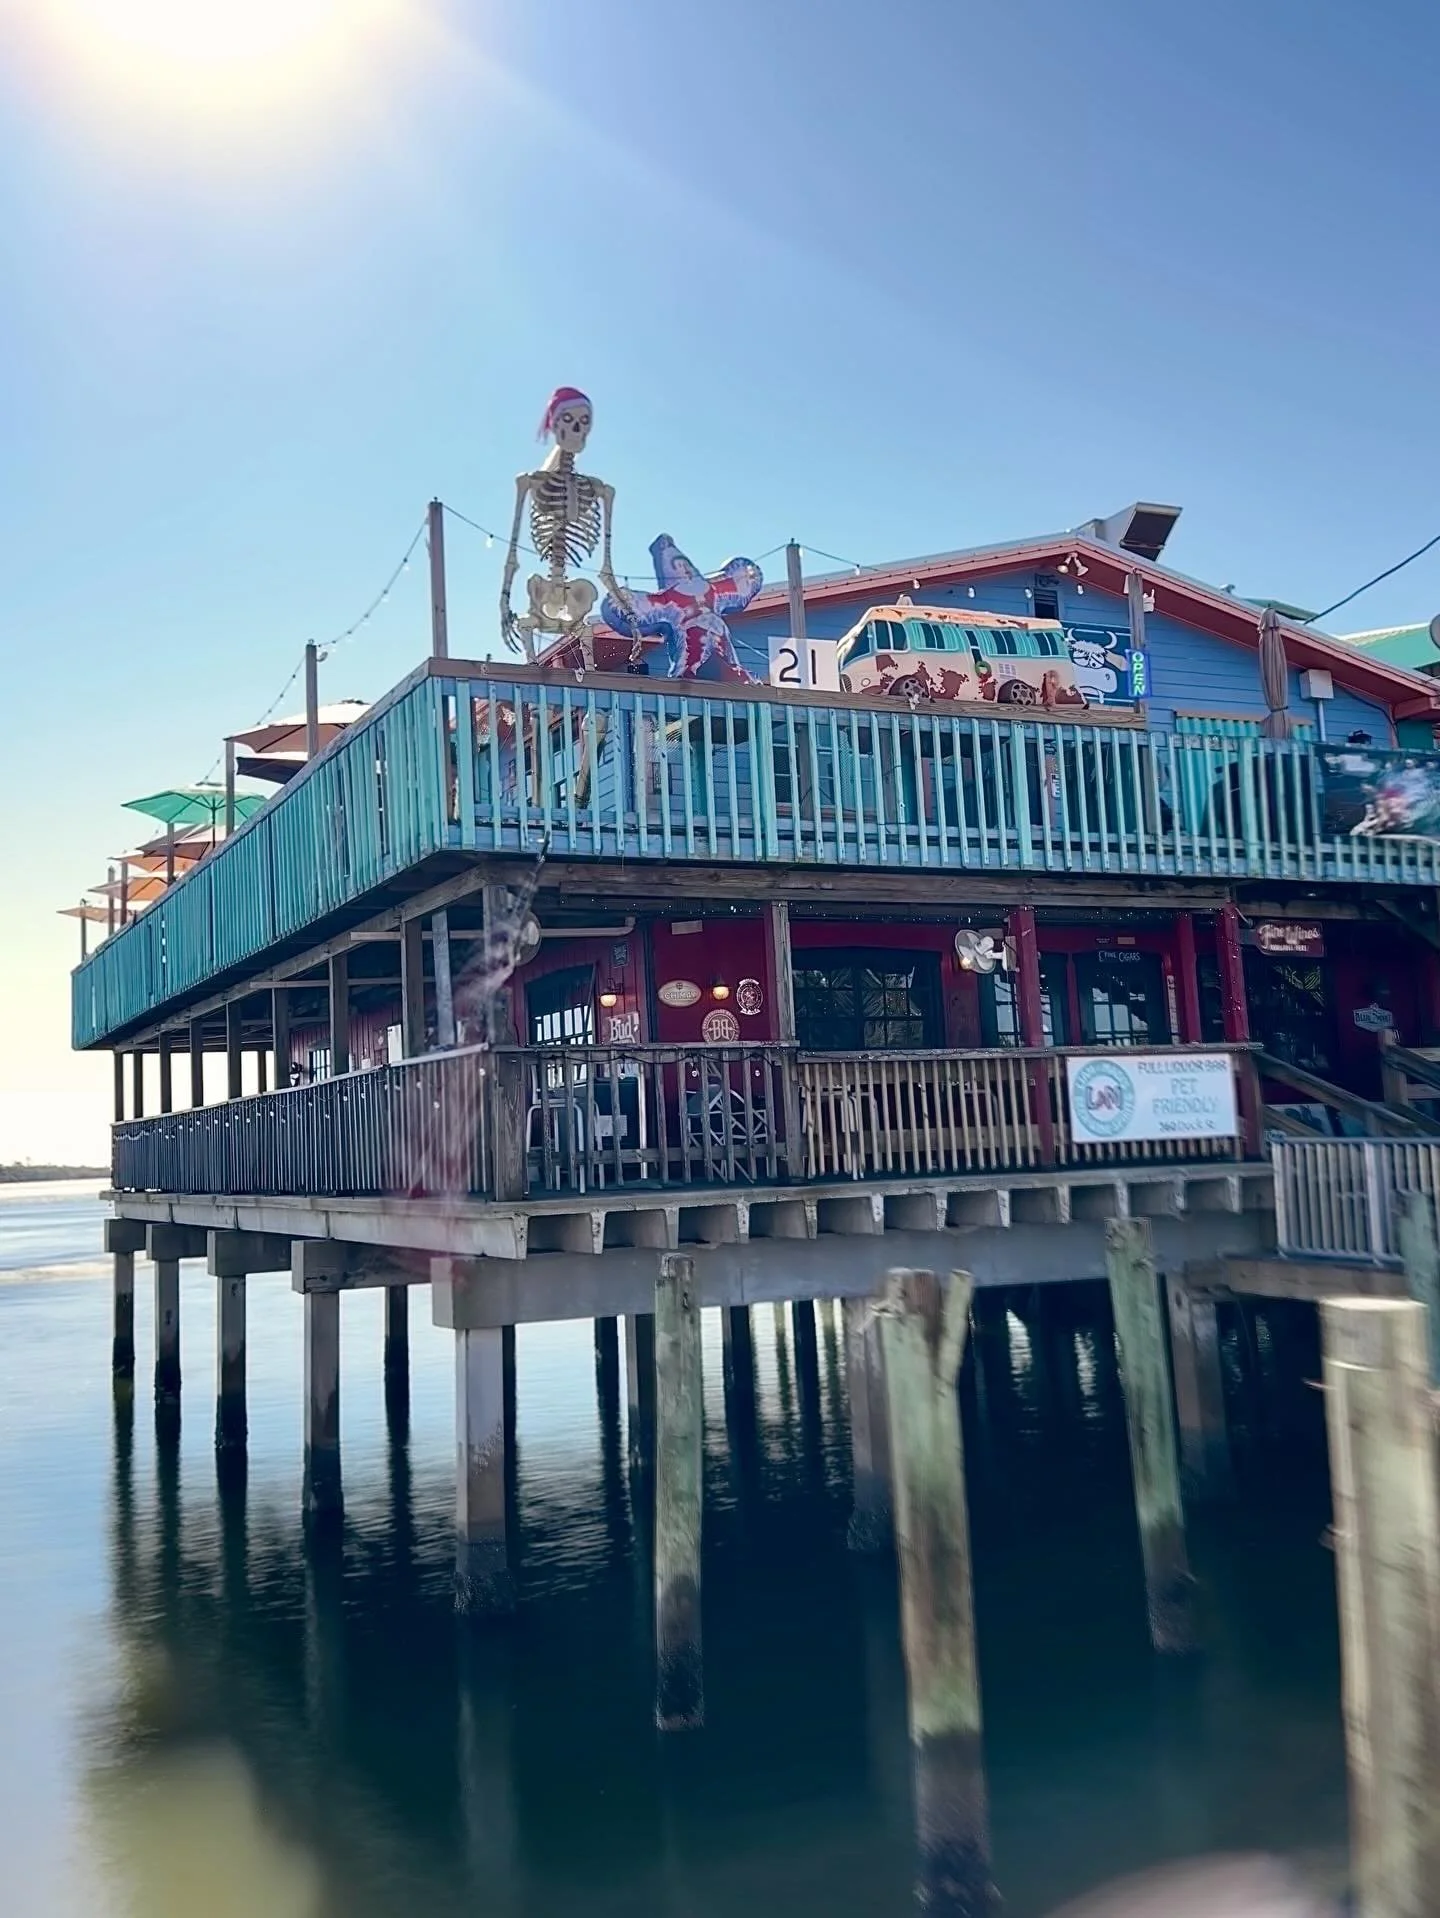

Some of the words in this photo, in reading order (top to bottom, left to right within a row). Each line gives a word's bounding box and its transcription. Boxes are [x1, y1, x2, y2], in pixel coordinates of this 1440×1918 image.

[779, 648, 817, 685] 21
[1132, 651, 1145, 696] OPEN
[1138, 1061, 1163, 1074] FULL
[1171, 1078, 1198, 1095] PET
[1152, 1096, 1218, 1115] FRIENDLY
